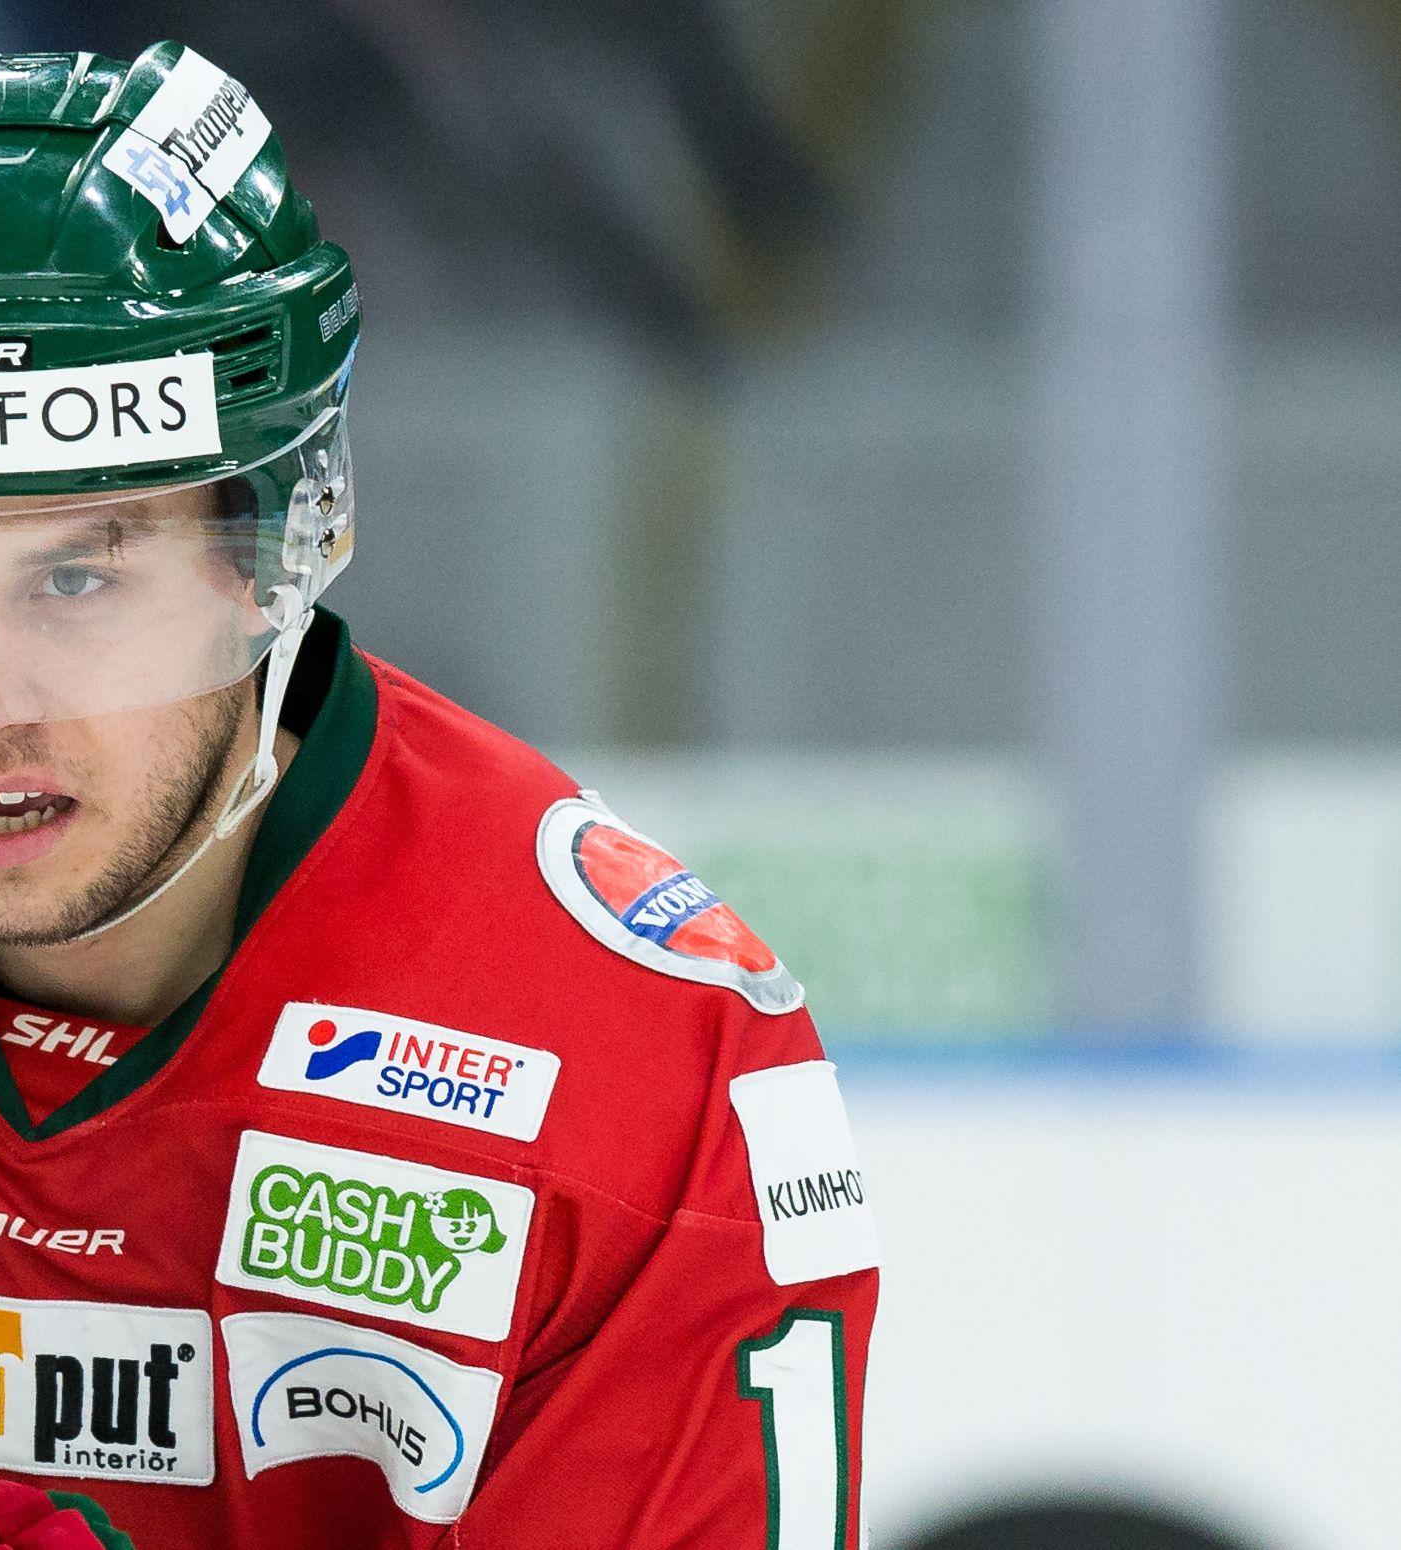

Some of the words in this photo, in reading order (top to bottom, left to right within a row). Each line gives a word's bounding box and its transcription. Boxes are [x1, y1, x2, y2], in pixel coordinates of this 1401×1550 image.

[630, 877, 715, 928] VOLV
[0, 1014, 118, 1066] SHL
[388, 1032, 513, 1087] INTER
[377, 1066, 505, 1118] SPORT
[258, 1172, 416, 1248] CASH
[248, 1221, 453, 1306] BUDDY
[286, 1386, 427, 1467] BOHUS
[736, 1307, 850, 1550] 1
[64, 1443, 178, 1472] interiör
